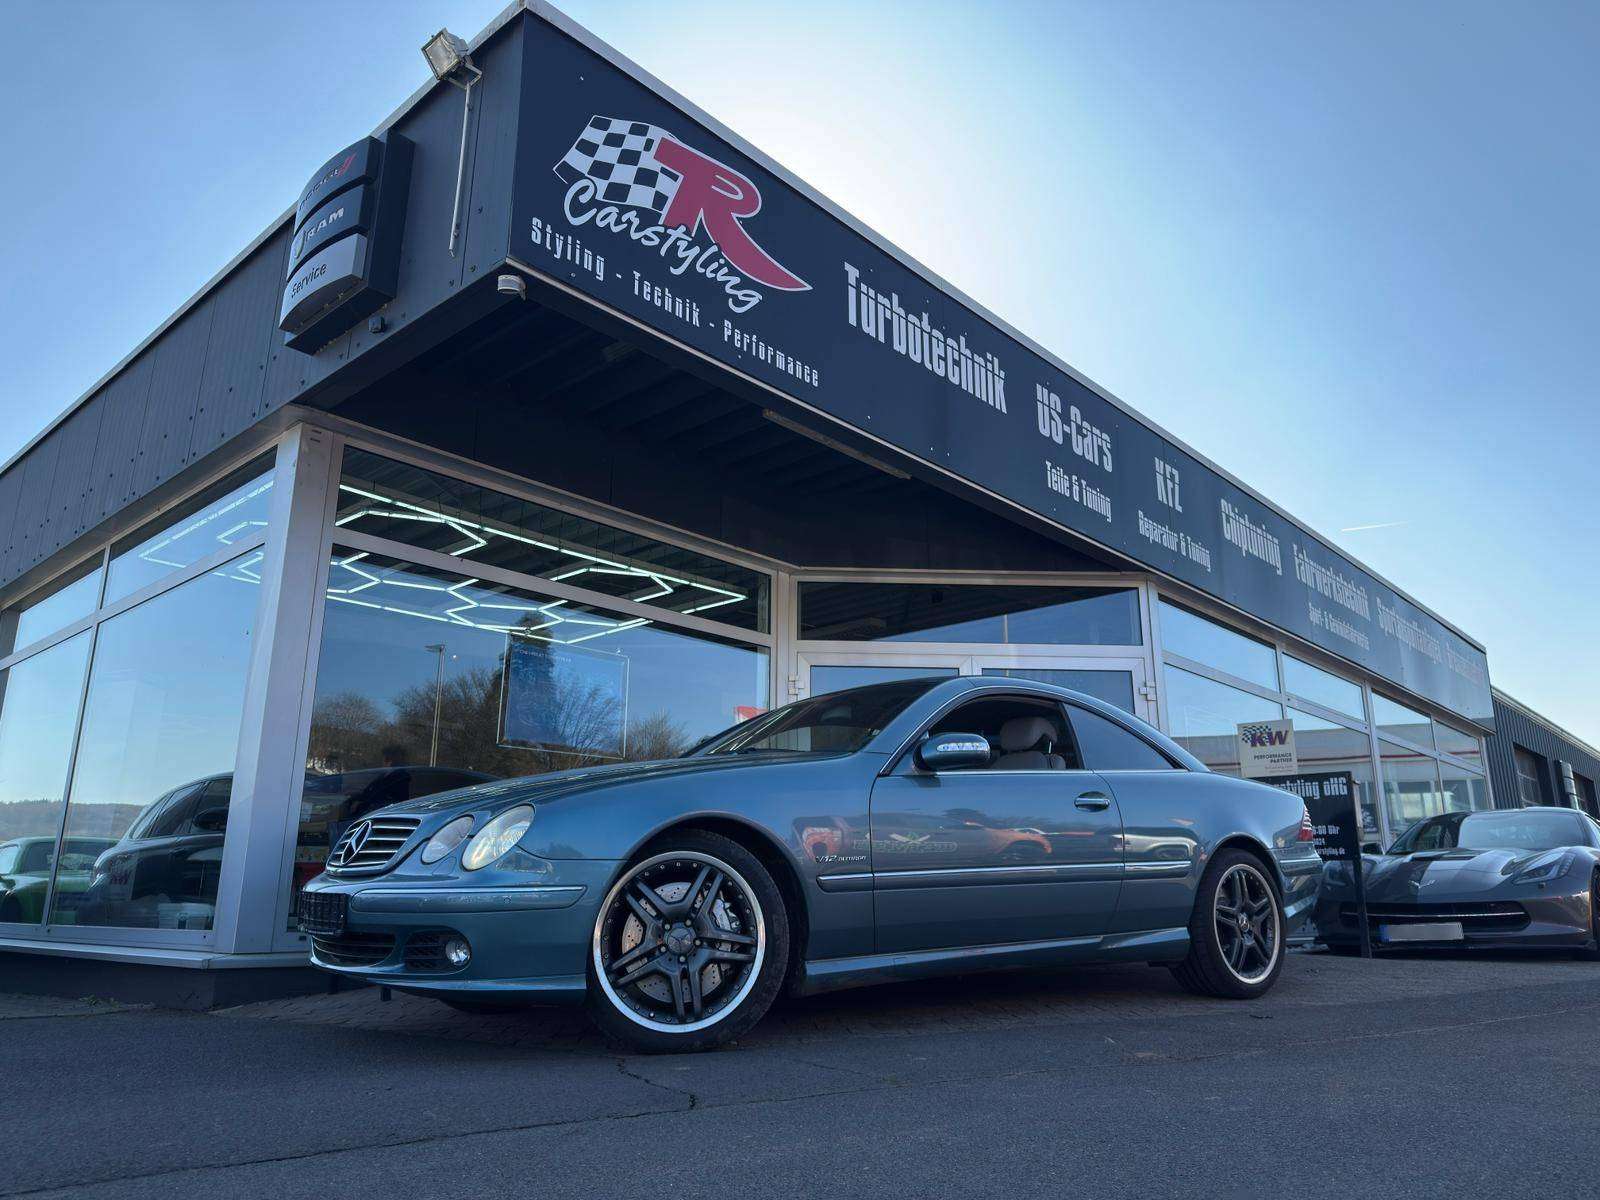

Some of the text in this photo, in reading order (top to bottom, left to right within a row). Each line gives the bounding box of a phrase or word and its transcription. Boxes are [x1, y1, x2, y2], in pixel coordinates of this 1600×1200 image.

[306, 207, 345, 240] RAM
[564, 178, 762, 314] Carstyling
[291, 262, 327, 298] Service
[531, 216, 605, 282] Styling
[633, 269, 700, 328] Technik
[724, 319, 818, 388] Performance
[844, 261, 1008, 414] Turbotechnik
[1036, 383, 1113, 473] US-Cars
[1045, 460, 1112, 523] Teile & Tuning
[1154, 457, 1183, 513] KFZ
[1138, 510, 1178, 553] Reparatur
[1187, 536, 1212, 573] Tuning
[1220, 498, 1283, 576] Chiptuning
[1250, 729, 1289, 747] KW
[815, 854, 837, 863] V12
[1327, 824, 1340, 834] Uhr
